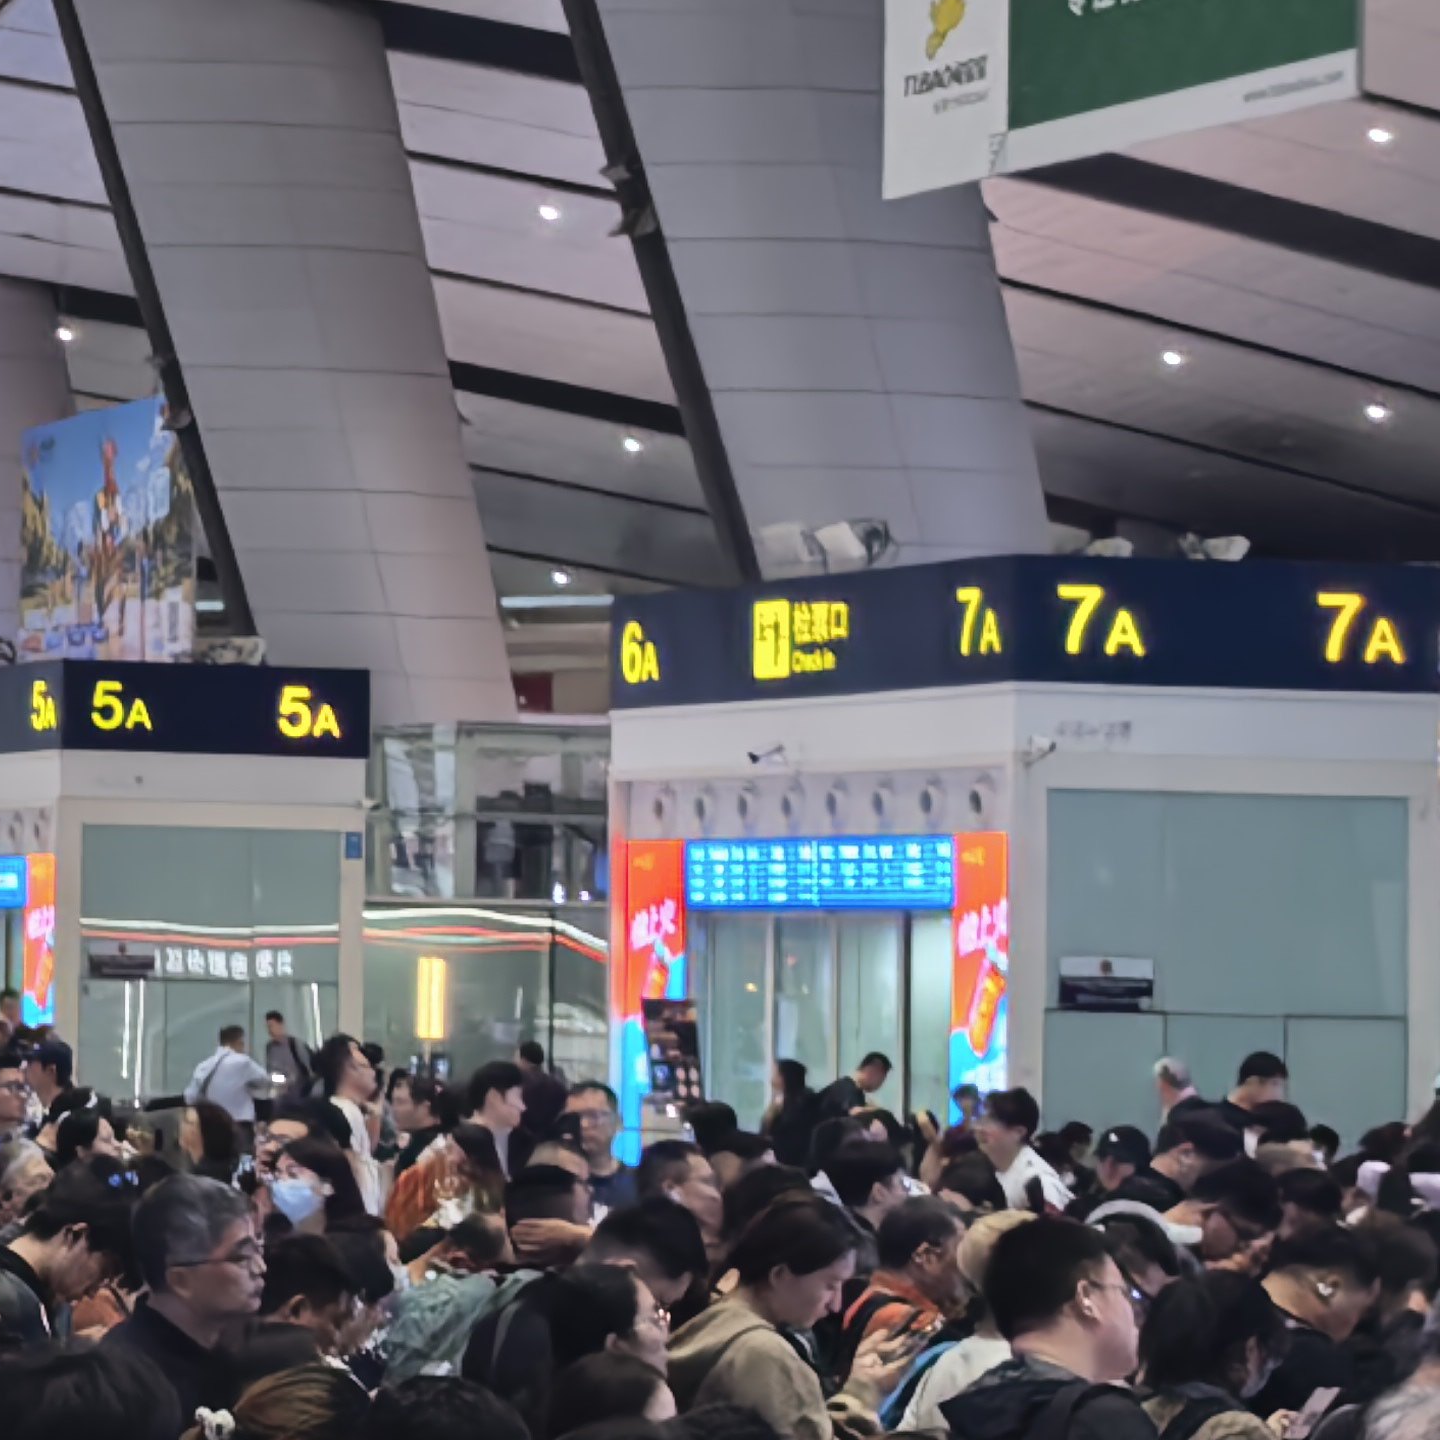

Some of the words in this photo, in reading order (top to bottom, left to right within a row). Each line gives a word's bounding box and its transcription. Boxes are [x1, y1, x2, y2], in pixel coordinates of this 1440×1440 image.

[793, 601, 849, 644] 检票口
[956, 586, 1003, 656] 7A
[1056, 583, 1148, 657] 7A
[1315, 590, 1407, 665] 7A
[622, 620, 661, 684] 6A
[31, 679, 57, 731] 5A
[90, 680, 154, 732] 5A
[277, 684, 342, 739] 5A
